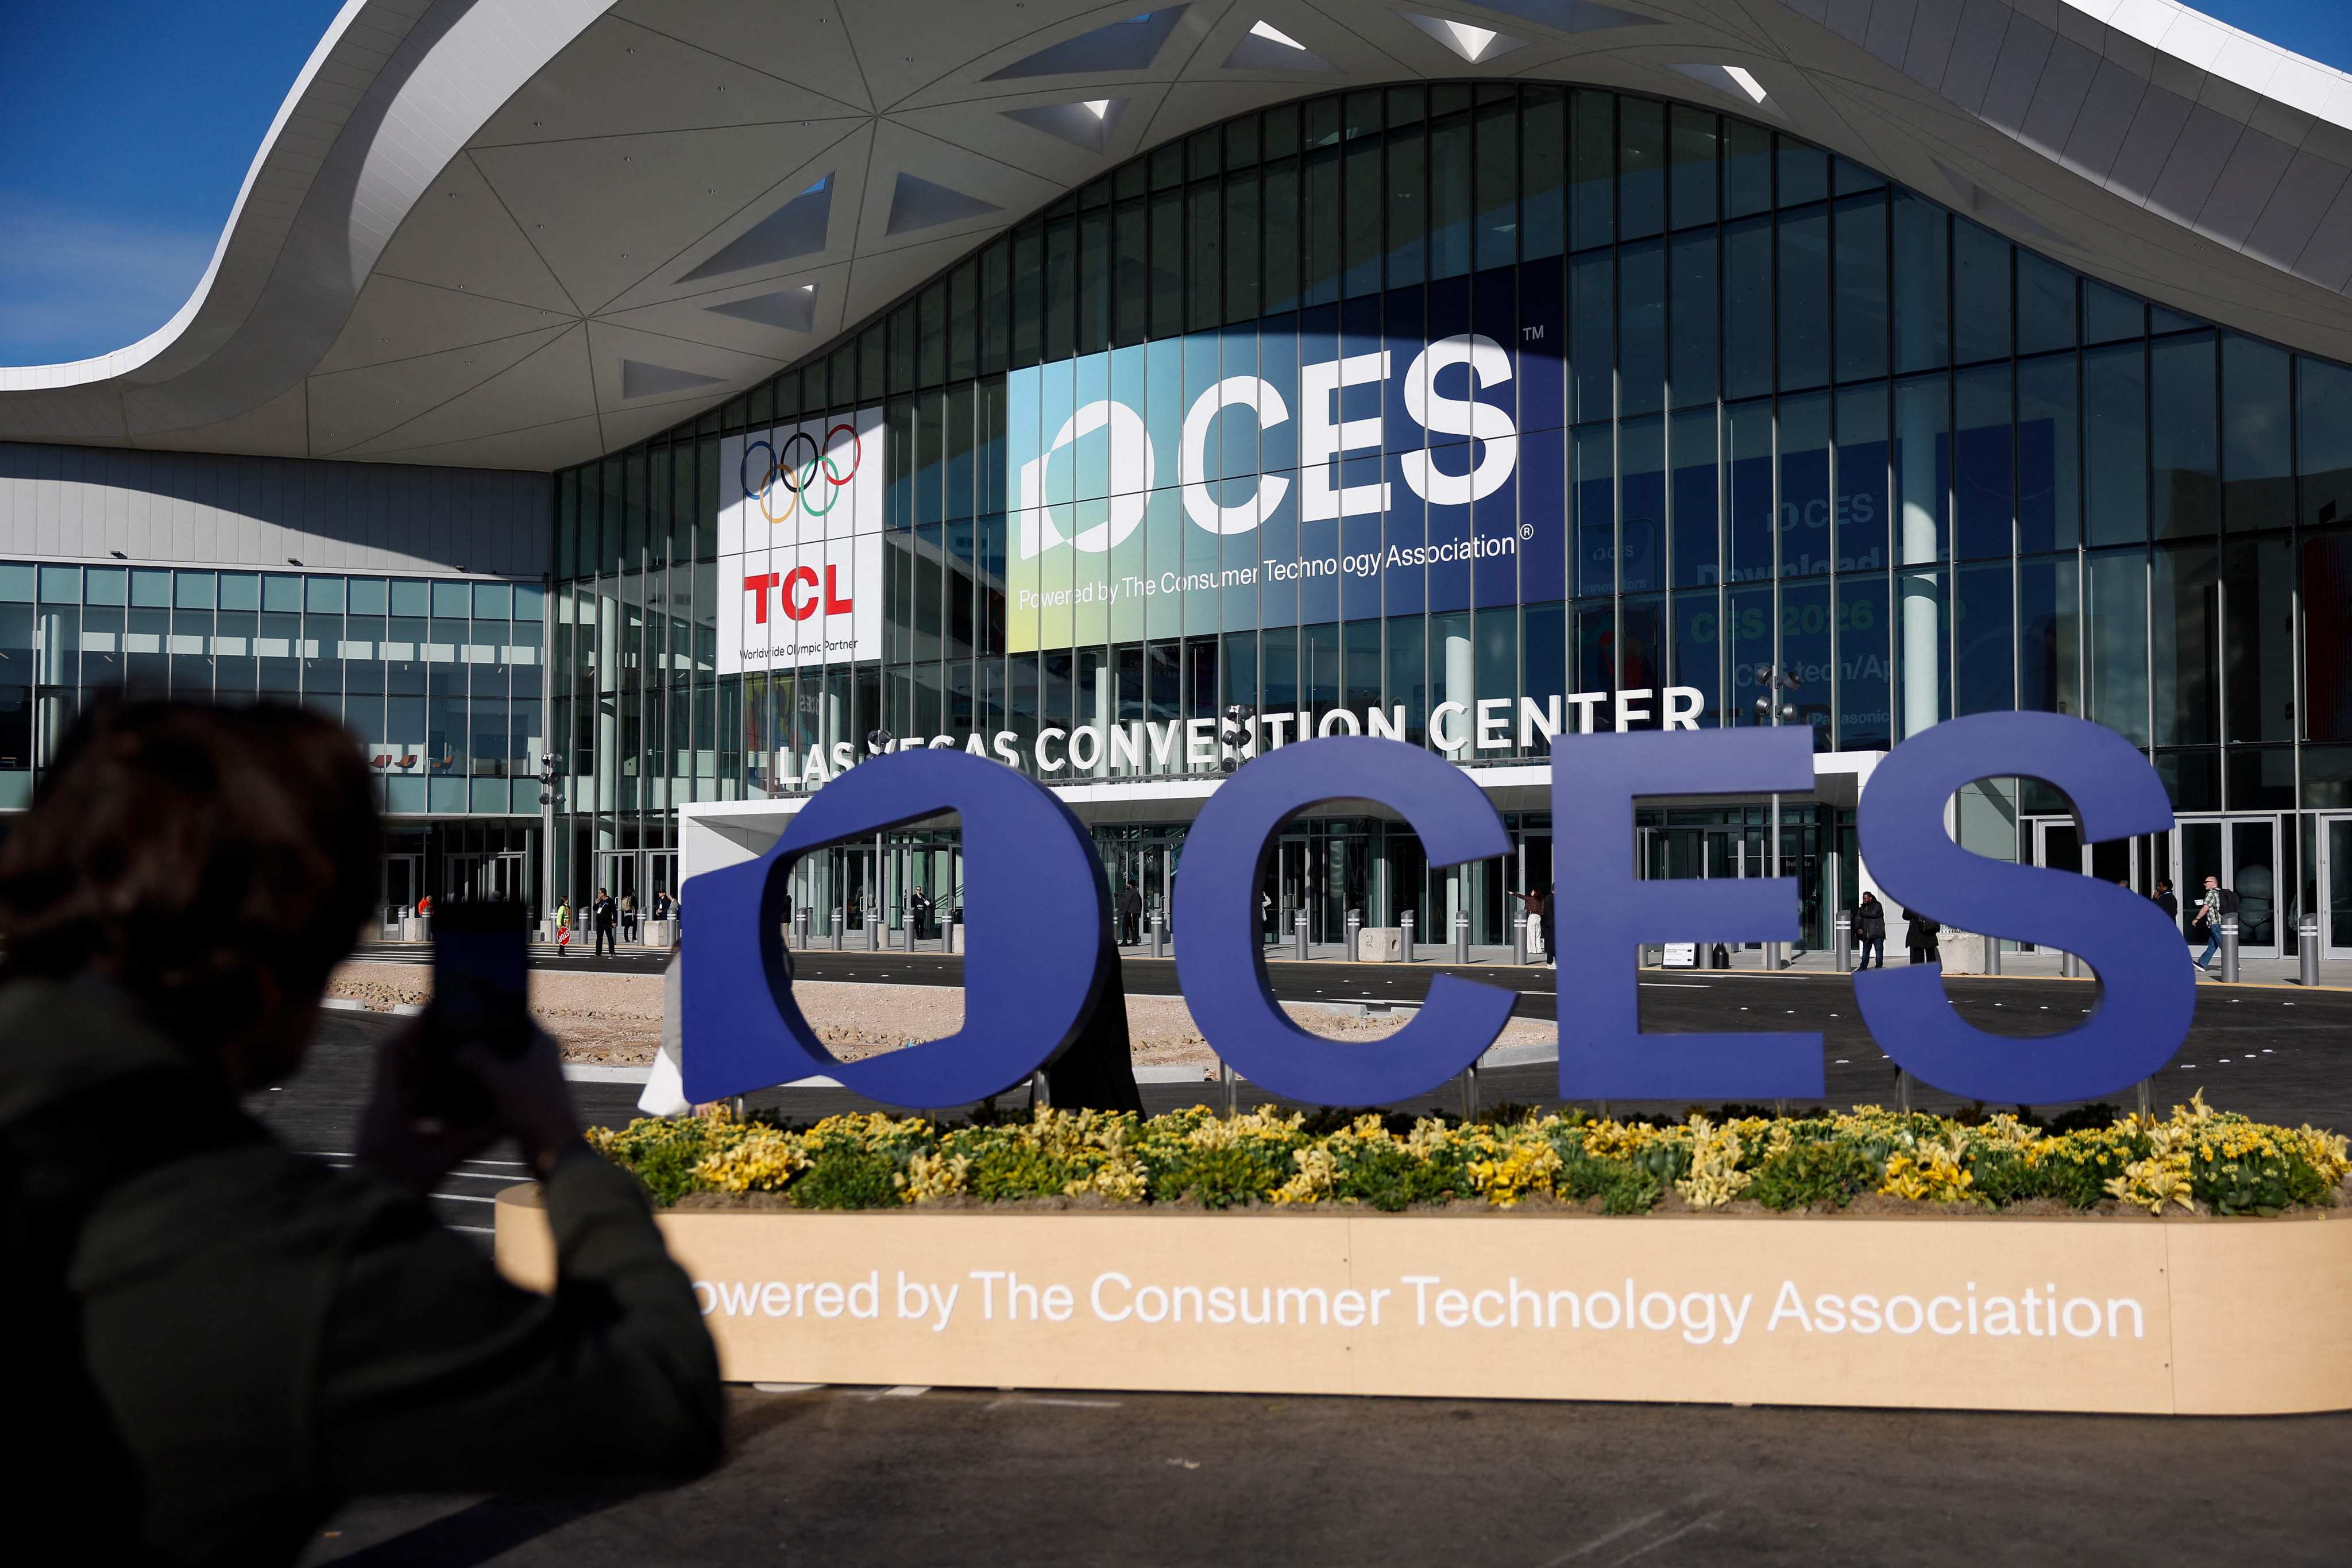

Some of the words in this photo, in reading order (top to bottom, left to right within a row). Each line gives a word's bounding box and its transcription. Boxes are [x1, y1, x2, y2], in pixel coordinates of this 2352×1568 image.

[1177, 334, 1517, 535] CES
[744, 564, 852, 624] TCL
[1019, 582, 1092, 609] Powered
[1098, 581, 1118, 605] by
[1122, 576, 1156, 598] The
[1161, 567, 1258, 594] Consumer
[1264, 552, 1381, 582] Technoogy
[1782, 599, 1874, 636] 2026
[787, 642, 821, 655] Olympic
[825, 640, 858, 651] Partner
[779, 741, 855, 785] LAS
[1036, 705, 1405, 771] CONVENTION
[1430, 687, 1704, 751] CENTER
[1812, 709, 1890, 726] Paasonic
[559, 929, 569, 943] STOP
[1172, 710, 2196, 1105] CES
[692, 1271, 879, 1319] owered
[898, 1270, 960, 1332] by
[969, 1270, 1074, 1320] The
[1090, 1271, 1391, 1327] Consumer
[1401, 1275, 1753, 1344] Technology
[1767, 1279, 2145, 1339] Association
